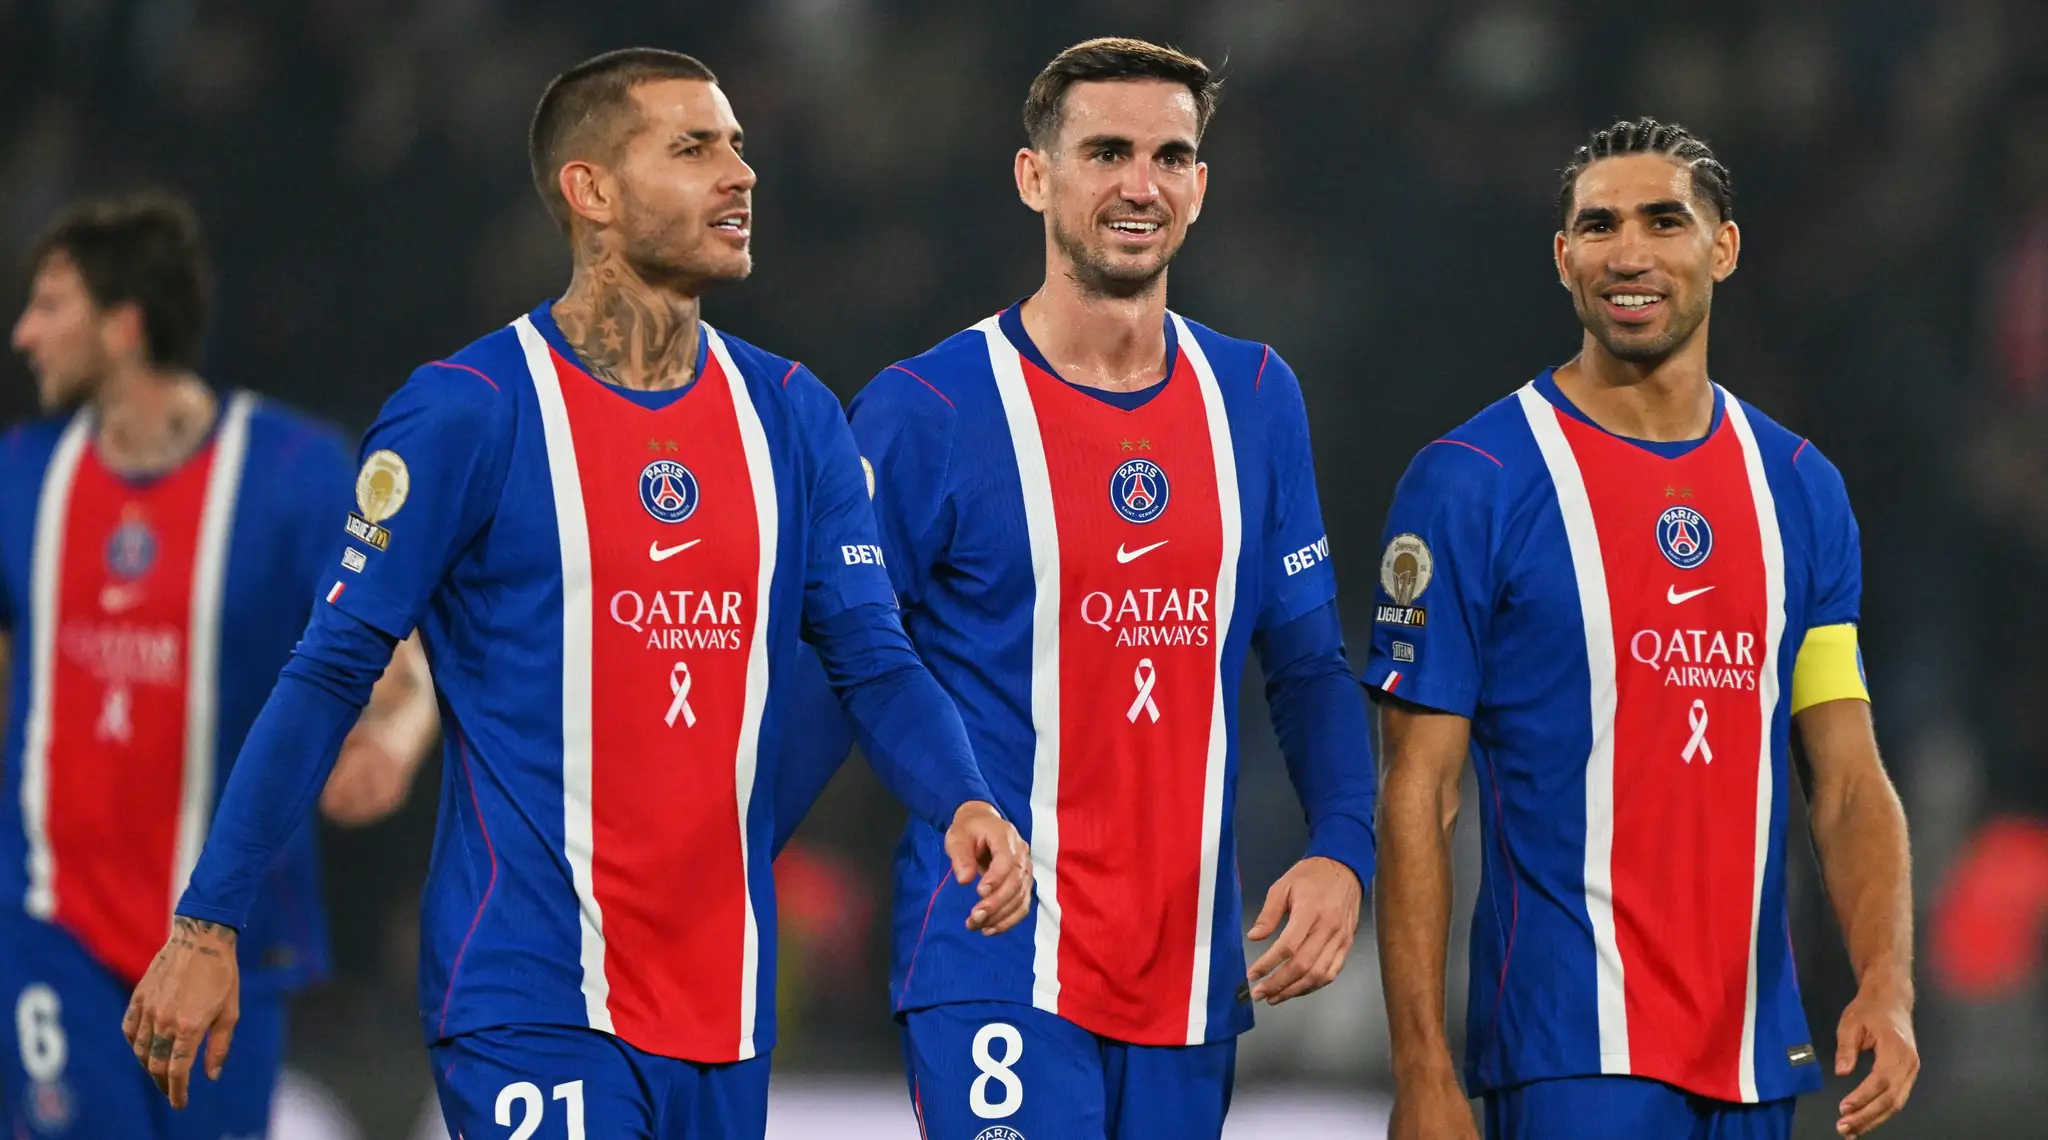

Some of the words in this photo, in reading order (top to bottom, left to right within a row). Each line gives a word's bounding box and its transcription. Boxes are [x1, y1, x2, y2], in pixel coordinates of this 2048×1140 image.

[645, 463, 684, 480] PARIS
[1119, 463, 1157, 479] PARIS
[1663, 509, 1700, 525] PARIS
[610, 590, 742, 633] QATAR
[1080, 588, 1209, 632] QATAR
[1376, 606, 1404, 623] LIGUE
[646, 629, 741, 650] AIRWAYS
[1115, 626, 1209, 647] AIRWAYS
[1631, 629, 1754, 671] QATAR
[1664, 666, 1755, 691] AIRWAYS
[15, 979, 69, 1082] 6
[969, 1023, 1023, 1119] 8
[495, 1080, 586, 1140] 21
